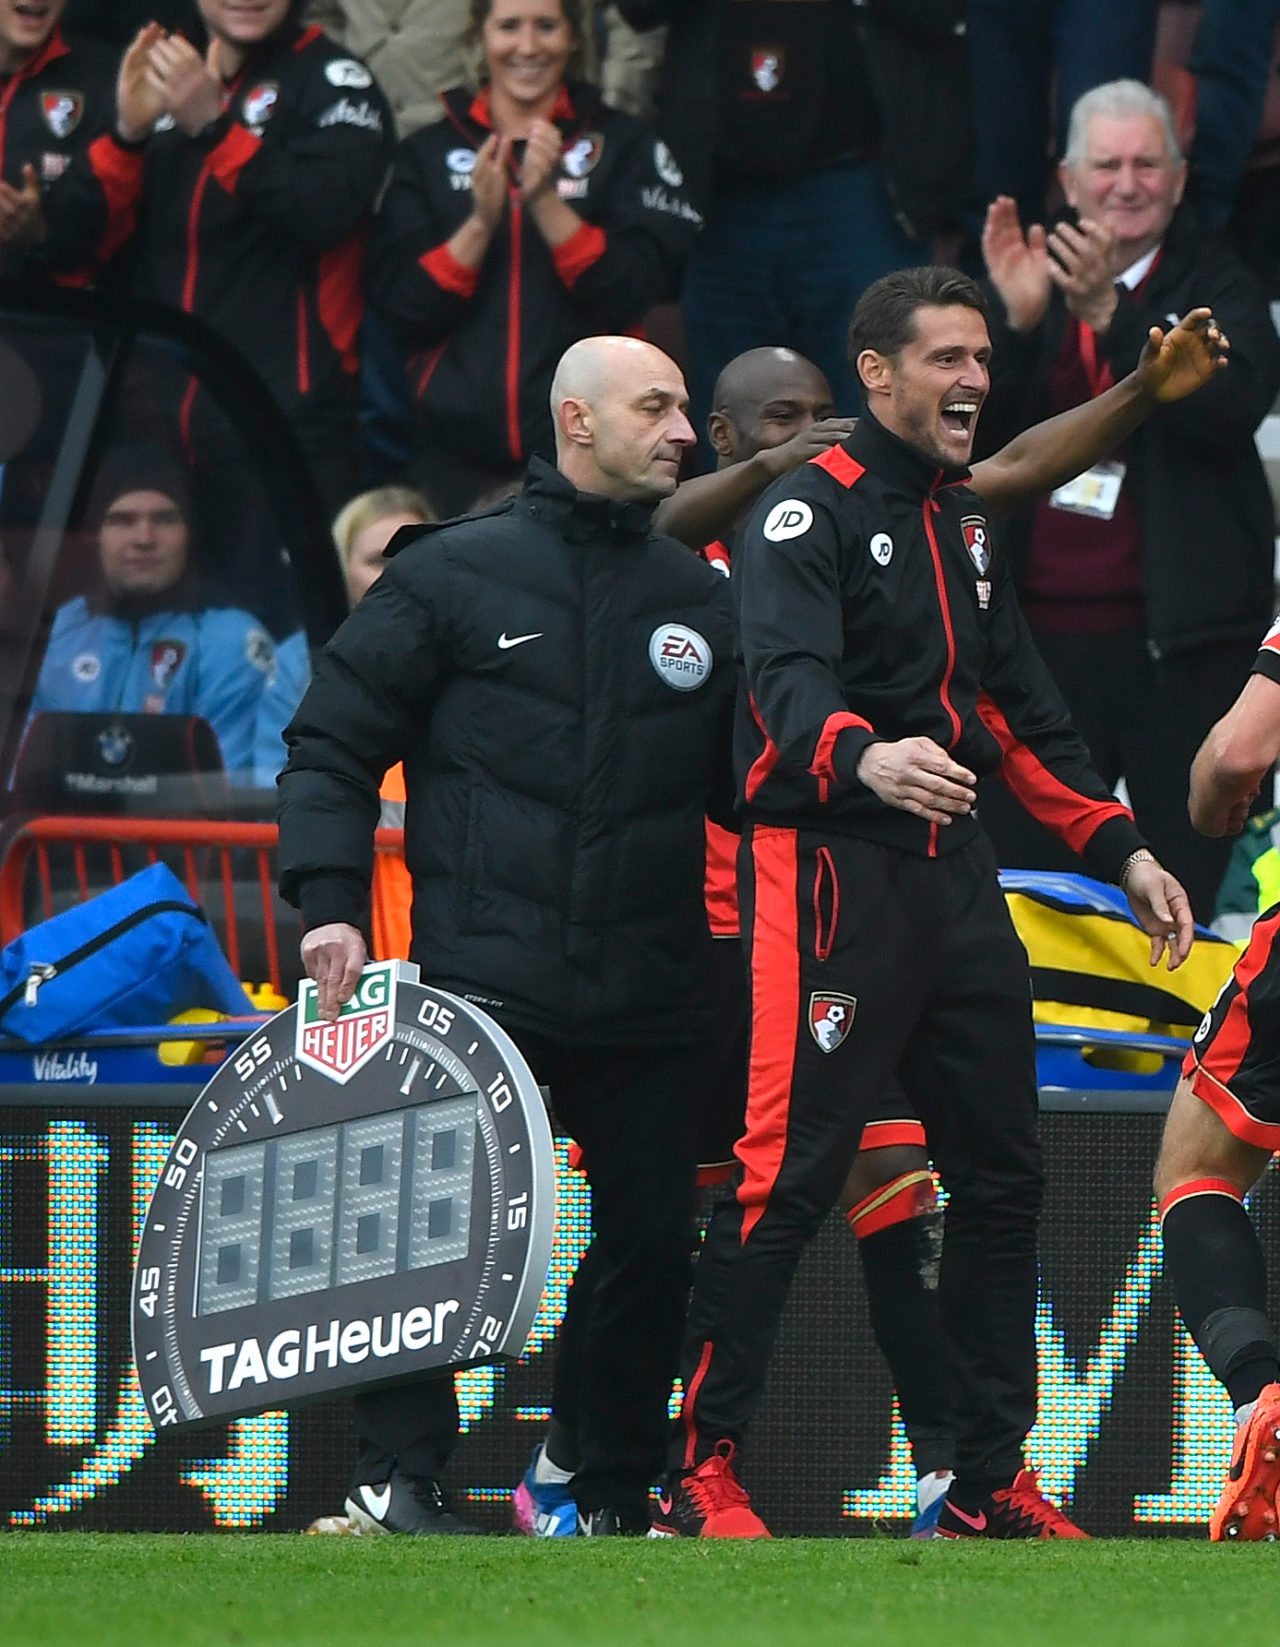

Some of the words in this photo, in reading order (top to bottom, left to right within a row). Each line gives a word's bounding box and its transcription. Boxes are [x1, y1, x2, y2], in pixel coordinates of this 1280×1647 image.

[770, 511, 804, 532] JD
[660, 635, 704, 663] EA
[660, 656, 704, 676] SPORTS
[417, 999, 455, 1036] 05
[234, 1036, 273, 1082] 55
[304, 1013, 387, 1071] HEUER
[34, 1052, 98, 1085] Vitality
[486, 1072, 513, 1113] 10
[165, 1138, 199, 1191] 50
[507, 1192, 529, 1231] 15
[139, 1266, 161, 1318] 45
